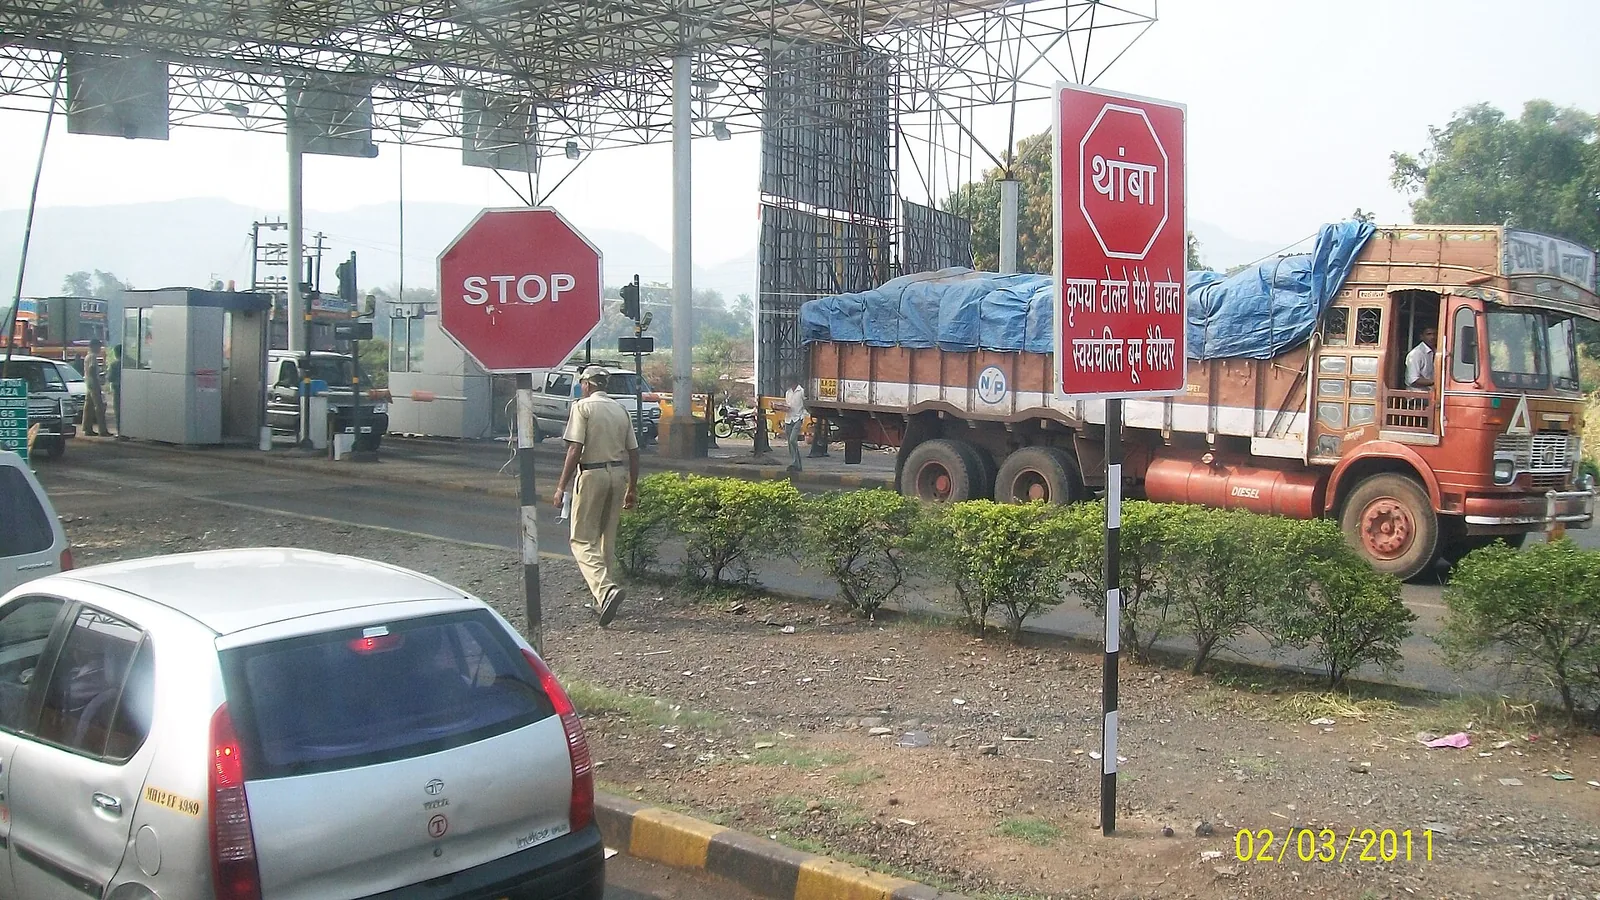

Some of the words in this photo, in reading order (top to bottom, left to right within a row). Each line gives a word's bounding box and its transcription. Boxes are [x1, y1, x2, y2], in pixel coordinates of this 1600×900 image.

[1092, 147, 1157, 205] थांबा
[463, 274, 576, 305] STOP
[1066, 278, 1097, 328] कृपया
[1100, 265, 1129, 314] टोलचे
[1154, 268, 1180, 314] द्यावेत
[1072, 326, 1124, 373] स्वयंचलित
[1127, 339, 1143, 384] बूम
[1231, 486, 1260, 499] DIESEL
[430, 818, 446, 835] T
